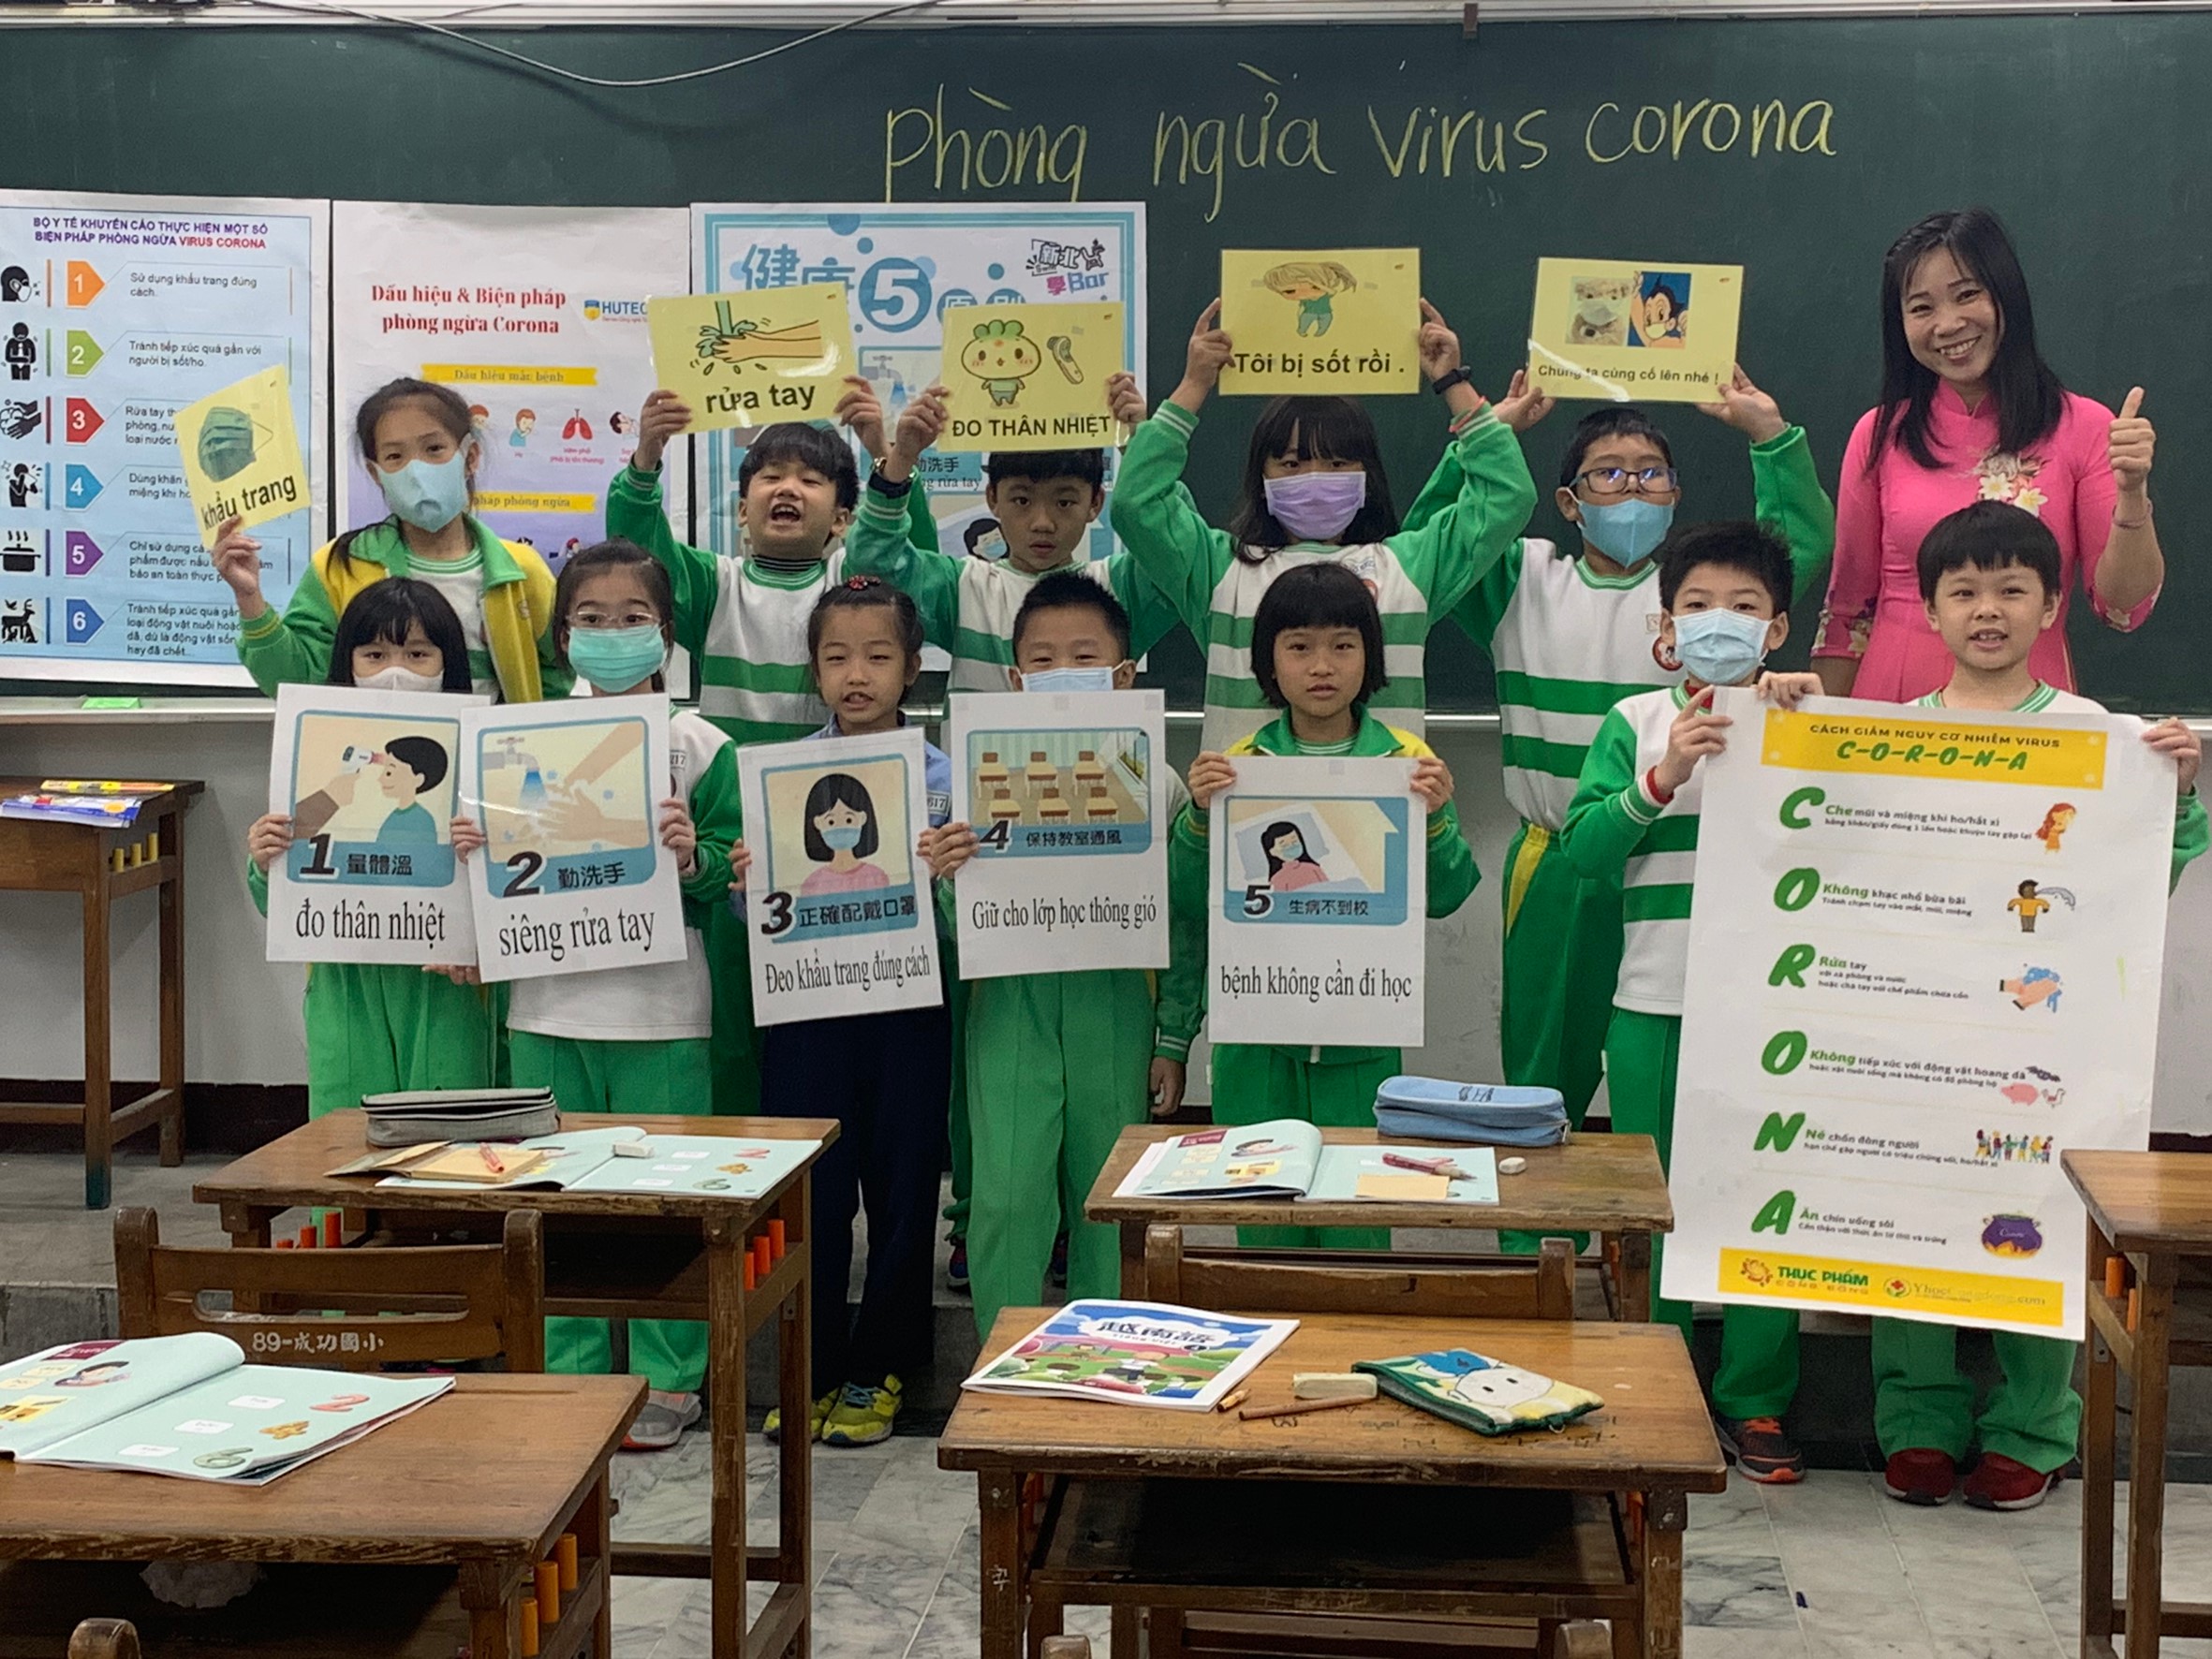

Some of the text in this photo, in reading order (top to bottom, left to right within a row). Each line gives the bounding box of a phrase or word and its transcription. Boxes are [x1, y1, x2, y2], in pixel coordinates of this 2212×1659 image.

[52, 217, 61, 228] Y
[130, 218, 155, 230] CÁO
[179, 236, 214, 247] VIRUS
[216, 237, 267, 249] CORONA
[74, 273, 83, 294] 1
[202, 275, 229, 288] trang
[372, 285, 567, 309] Dấu hiệu & Biện pháp
[602, 301, 648, 315] HUTEC
[382, 314, 559, 335] phòng ngừa Corona
[71, 345, 84, 364] 2
[1234, 346, 1393, 378] Tôi bị sốt rồi
[1659, 369, 1681, 381] lên
[705, 384, 816, 413] rửa tay
[72, 410, 85, 430] 3
[149, 406, 165, 419] tay
[951, 413, 1112, 439] ĐO THÂN NHIỆT
[70, 477, 84, 496] 4
[242, 475, 298, 511] trang
[72, 546, 85, 565] 5
[73, 611, 86, 631] 6
[1809, 724, 1850, 735] CÁCH
[1895, 729, 1935, 740] NGUY
[2015, 737, 2060, 748] VIRUS
[1779, 786, 1826, 830] C
[1825, 804, 1853, 816] Che
[980, 820, 1010, 850] 4
[1025, 829, 1123, 848] 保持教室通風
[300, 833, 336, 876] 1
[347, 853, 413, 876] 量體溫
[503, 851, 544, 898] 2
[557, 861, 626, 889] 勤洗手
[1244, 885, 1272, 916] 5
[1773, 867, 1821, 912] O
[1823, 883, 1869, 900] Không
[760, 892, 793, 934] 3
[799, 894, 917, 929] 正確配戴口罩
[972, 894, 1157, 934] Giữ cho lớp học thông gió
[1289, 899, 1369, 918] 生病不到校
[296, 899, 446, 949] đo thân nhiệt
[499, 905, 656, 962] siêng rửa tay
[766, 946, 931, 993] Đeo khẩu trang đúng cách
[1767, 943, 1816, 989] R
[1220, 959, 1412, 1009] bệnh không cần đi học
[1761, 1030, 1808, 1076] O
[1810, 1050, 1856, 1066] Không
[1753, 1111, 1806, 1152] N
[1750, 1190, 1796, 1235] A
